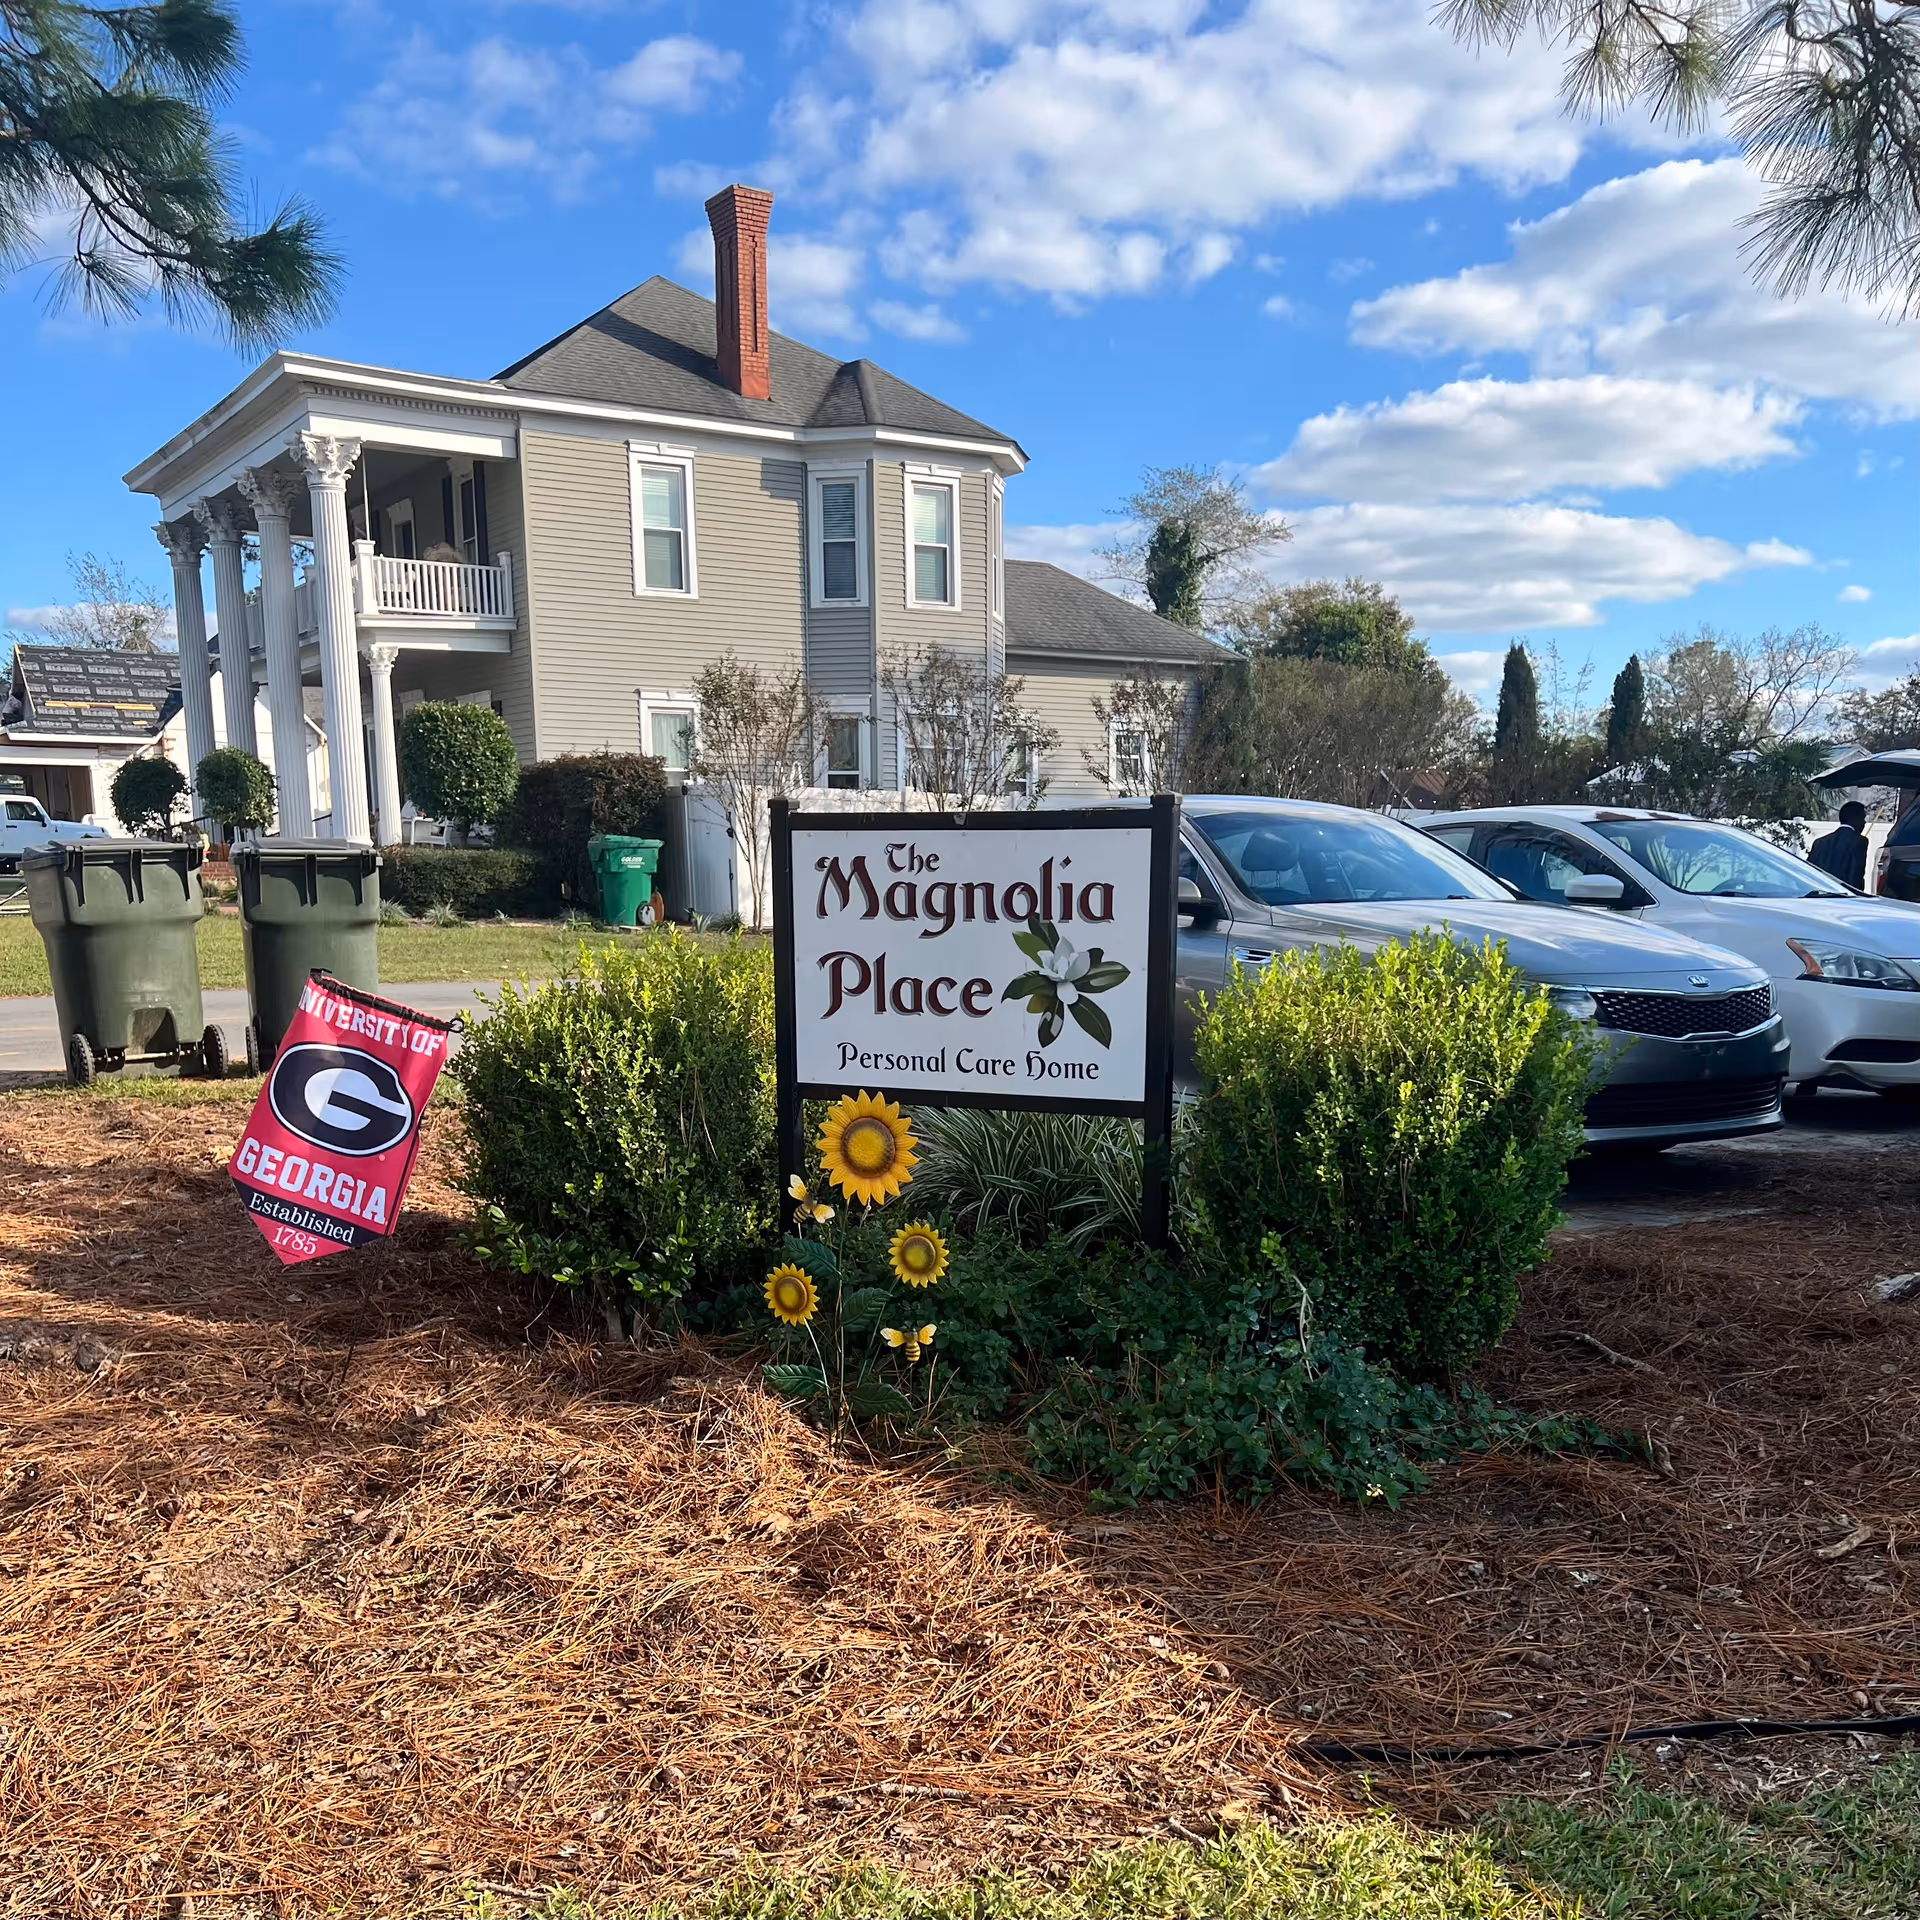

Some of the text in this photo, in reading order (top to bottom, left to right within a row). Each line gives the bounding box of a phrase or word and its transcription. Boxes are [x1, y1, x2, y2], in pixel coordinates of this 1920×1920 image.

[883, 842, 940, 874] The
[815, 855, 1116, 939] Magnolia
[816, 950, 994, 1020] Place
[299, 986, 444, 1057] NIVERSITY OF
[836, 1041, 1100, 1081] Personal Care Home
[269, 1042, 415, 1158] G
[236, 1137, 387, 1225] GEORGIA
[248, 1192, 355, 1244] Established
[272, 1225, 319, 1256] 1785
